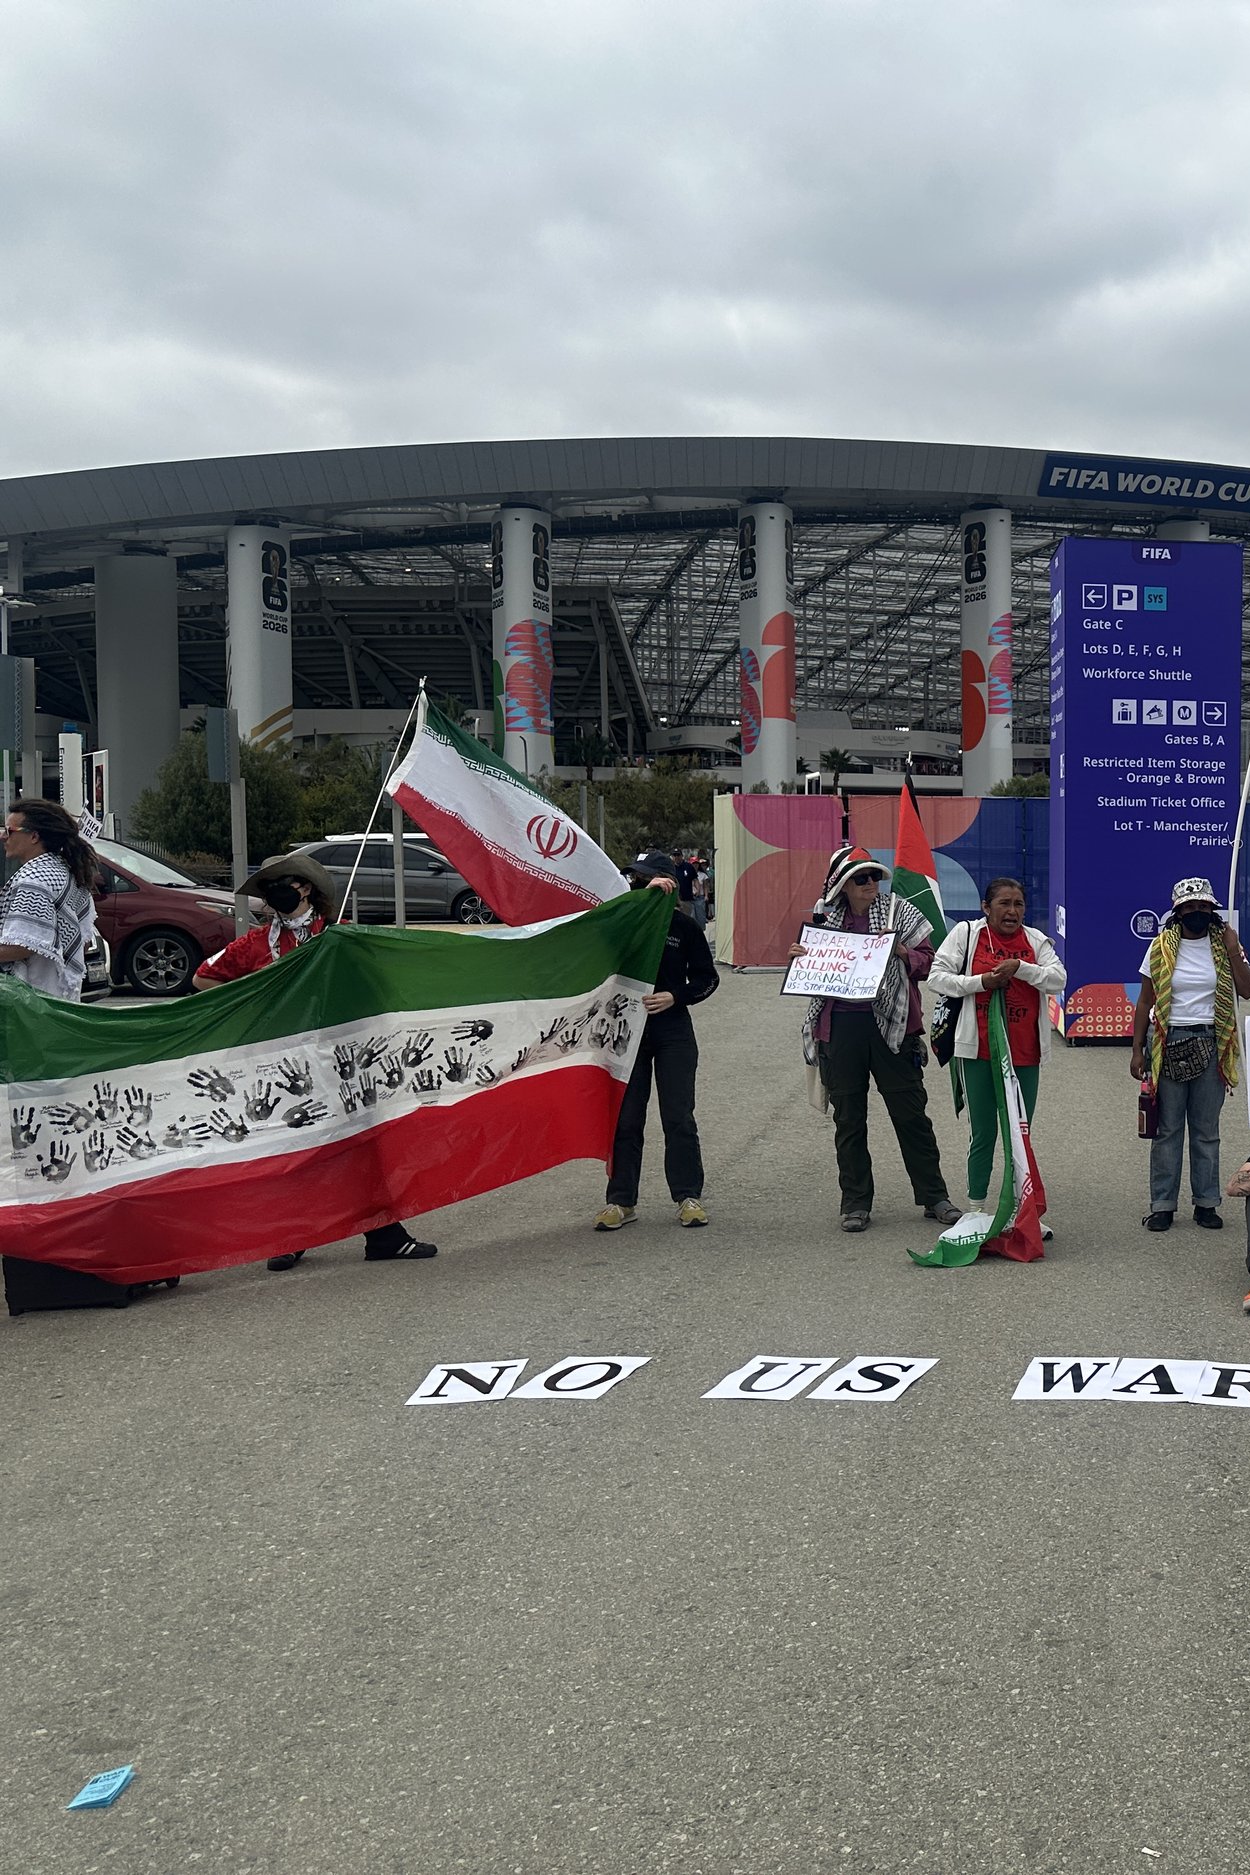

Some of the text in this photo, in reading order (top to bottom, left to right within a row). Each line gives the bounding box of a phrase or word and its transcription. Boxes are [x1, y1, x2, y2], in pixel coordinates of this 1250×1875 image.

[1049, 466, 1109, 491] FIFA
[1116, 471, 1215, 499] WORLD
[1142, 547, 1171, 559] FIFA
[964, 591, 987, 603] 2026
[1147, 593, 1164, 604] SYS
[262, 620, 288, 634] 2026
[1082, 618, 1124, 630] Gate C
[1083, 643, 1182, 657] Lots D, E, F, G, H
[1082, 667, 1192, 681] Workforce Shuttle
[1164, 733, 1225, 746] Gates B, A
[1083, 756, 1226, 771] Restricted Item Storage
[1126, 772, 1170, 786] Orange
[1174, 773, 1184, 784] &
[1187, 773, 1225, 785] Brown
[1097, 796, 1225, 808] Stadium Ticket Office
[1114, 820, 1133, 831] Lot
[1136, 821, 1143, 831] T
[1153, 820, 1228, 832] Manchester/
[82, 827, 94, 840] ICE
[1189, 835, 1228, 846] Prairie
[802, 929, 890, 950] ISRAEL: STOP
[789, 969, 879, 987] JOURNALISTS
[804, 982, 825, 991] STOP
[824, 984, 857, 996] BACKING
[420, 1362, 623, 1399] NO
[738, 1361, 915, 1394] US
